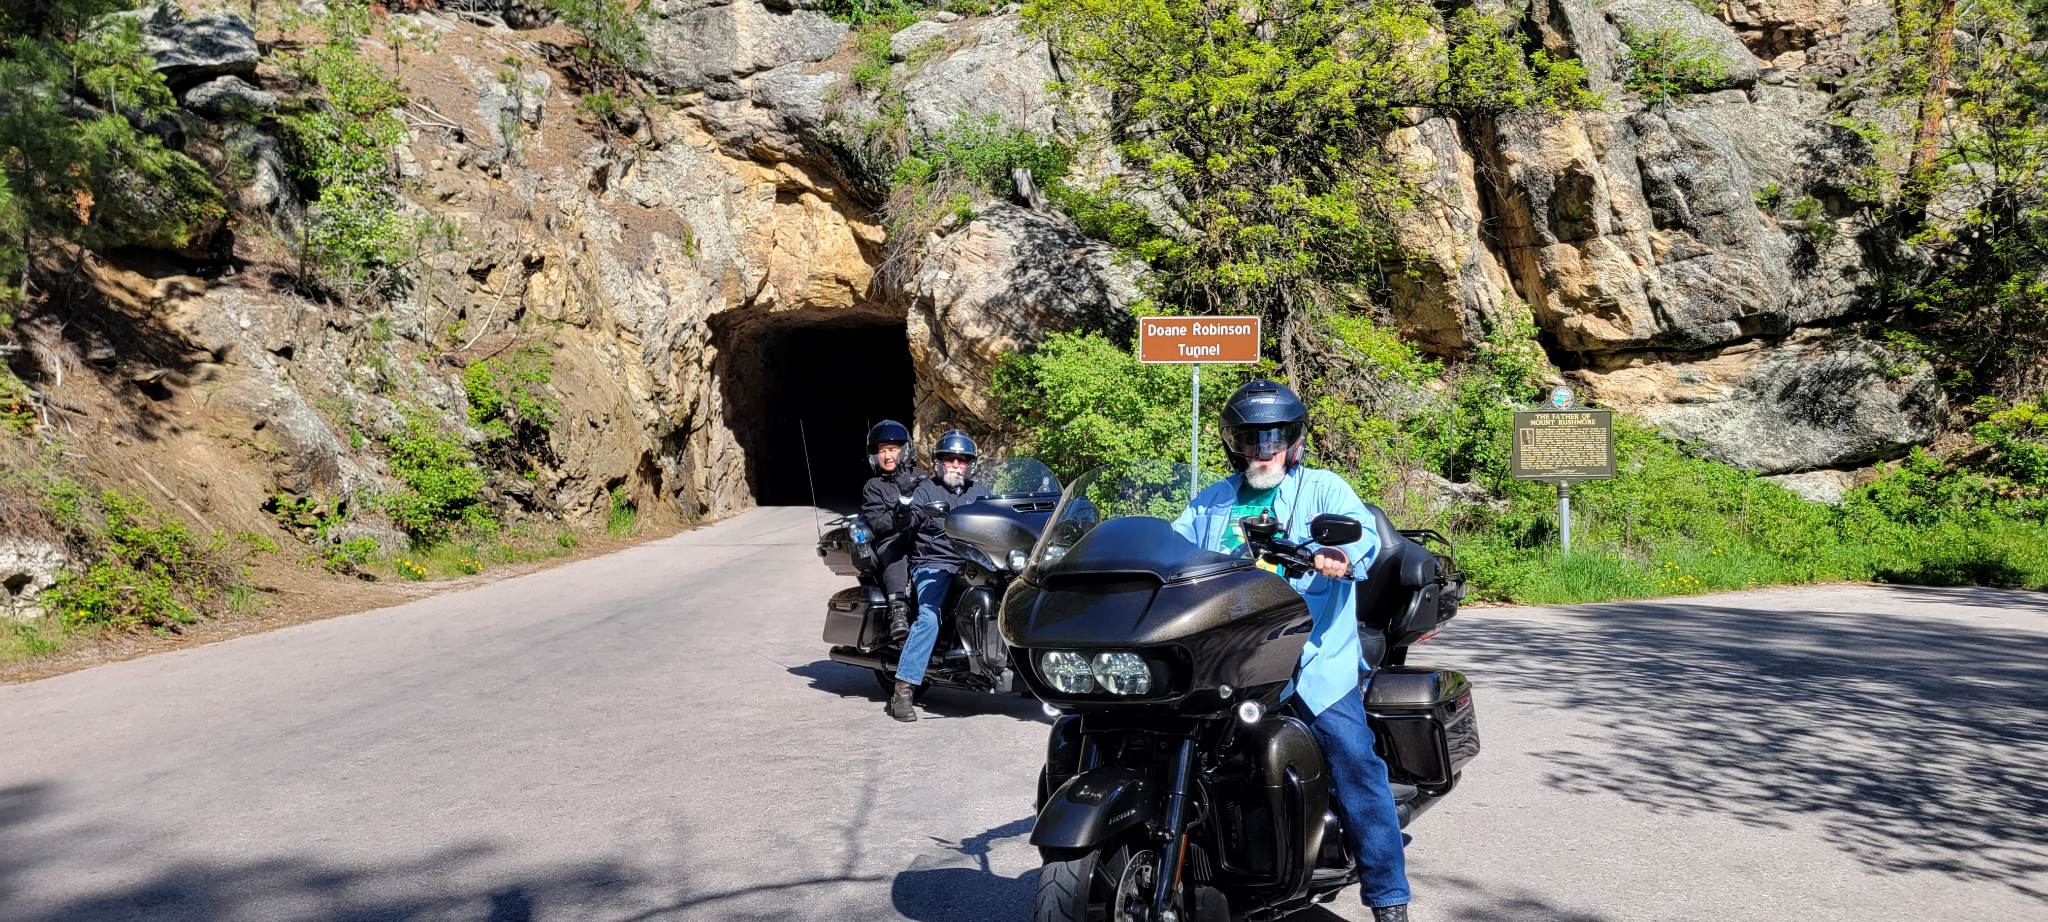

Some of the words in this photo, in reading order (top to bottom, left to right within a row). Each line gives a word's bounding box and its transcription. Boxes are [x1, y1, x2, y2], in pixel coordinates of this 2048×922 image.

[1147, 324, 1187, 336] Doane
[1193, 323, 1251, 336] Robinson
[1178, 343, 1220, 356] Tunnel
